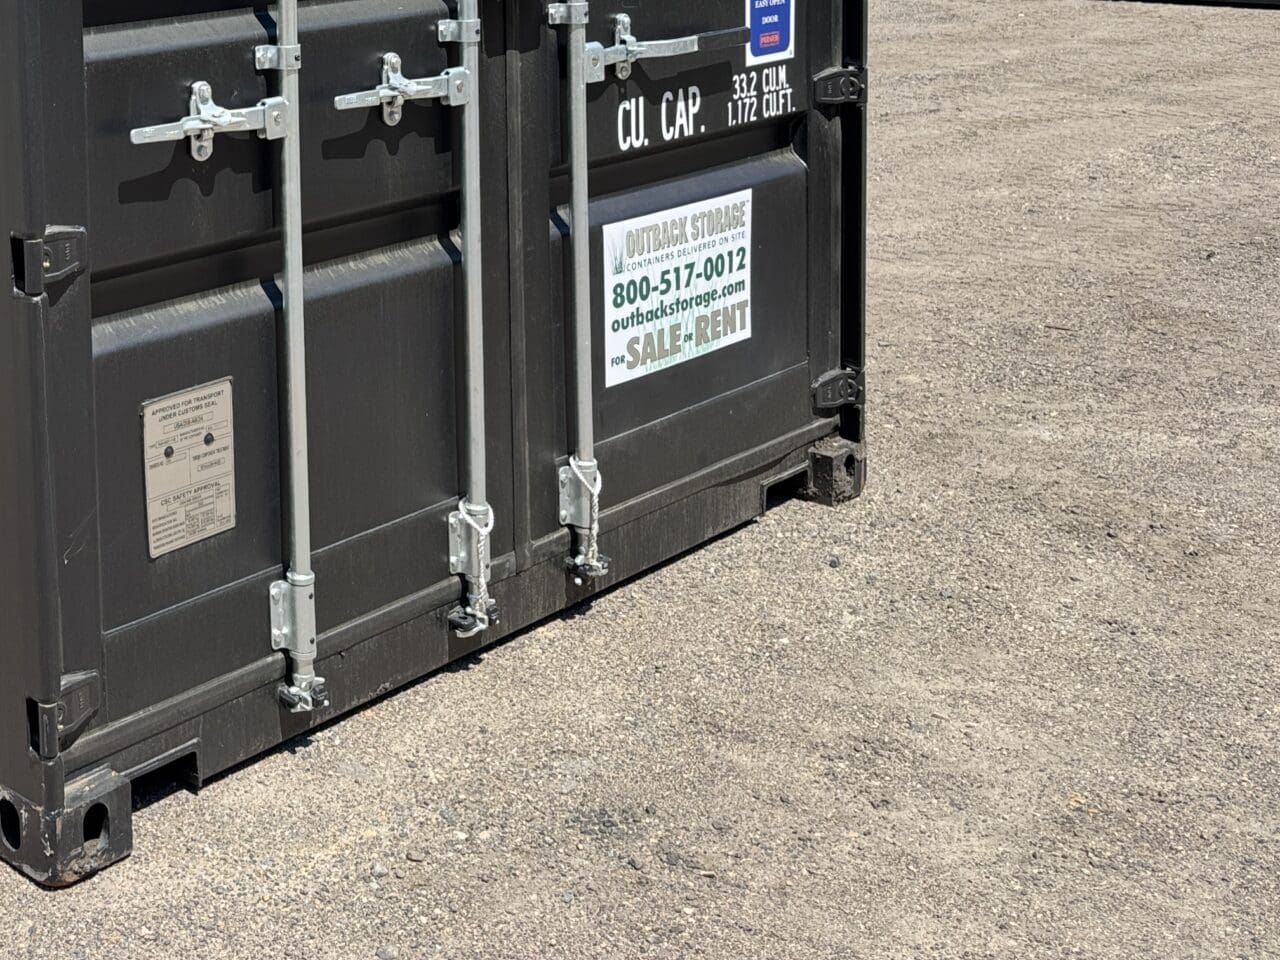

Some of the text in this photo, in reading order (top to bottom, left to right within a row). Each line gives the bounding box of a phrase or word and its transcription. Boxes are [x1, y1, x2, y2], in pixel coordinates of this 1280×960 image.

[732, 64, 790, 100] 33.2 CU.M.
[618, 85, 706, 152] CU. CAP.
[626, 200, 745, 259] OUTBACK STORAGE
[626, 230, 745, 272] CONTAINERS DELIVERED ON SITE
[611, 279, 745, 333] outbackstorage.com
[612, 246, 746, 309] 800-517-0012
[611, 300, 748, 370] FOR SALE OR RENT
